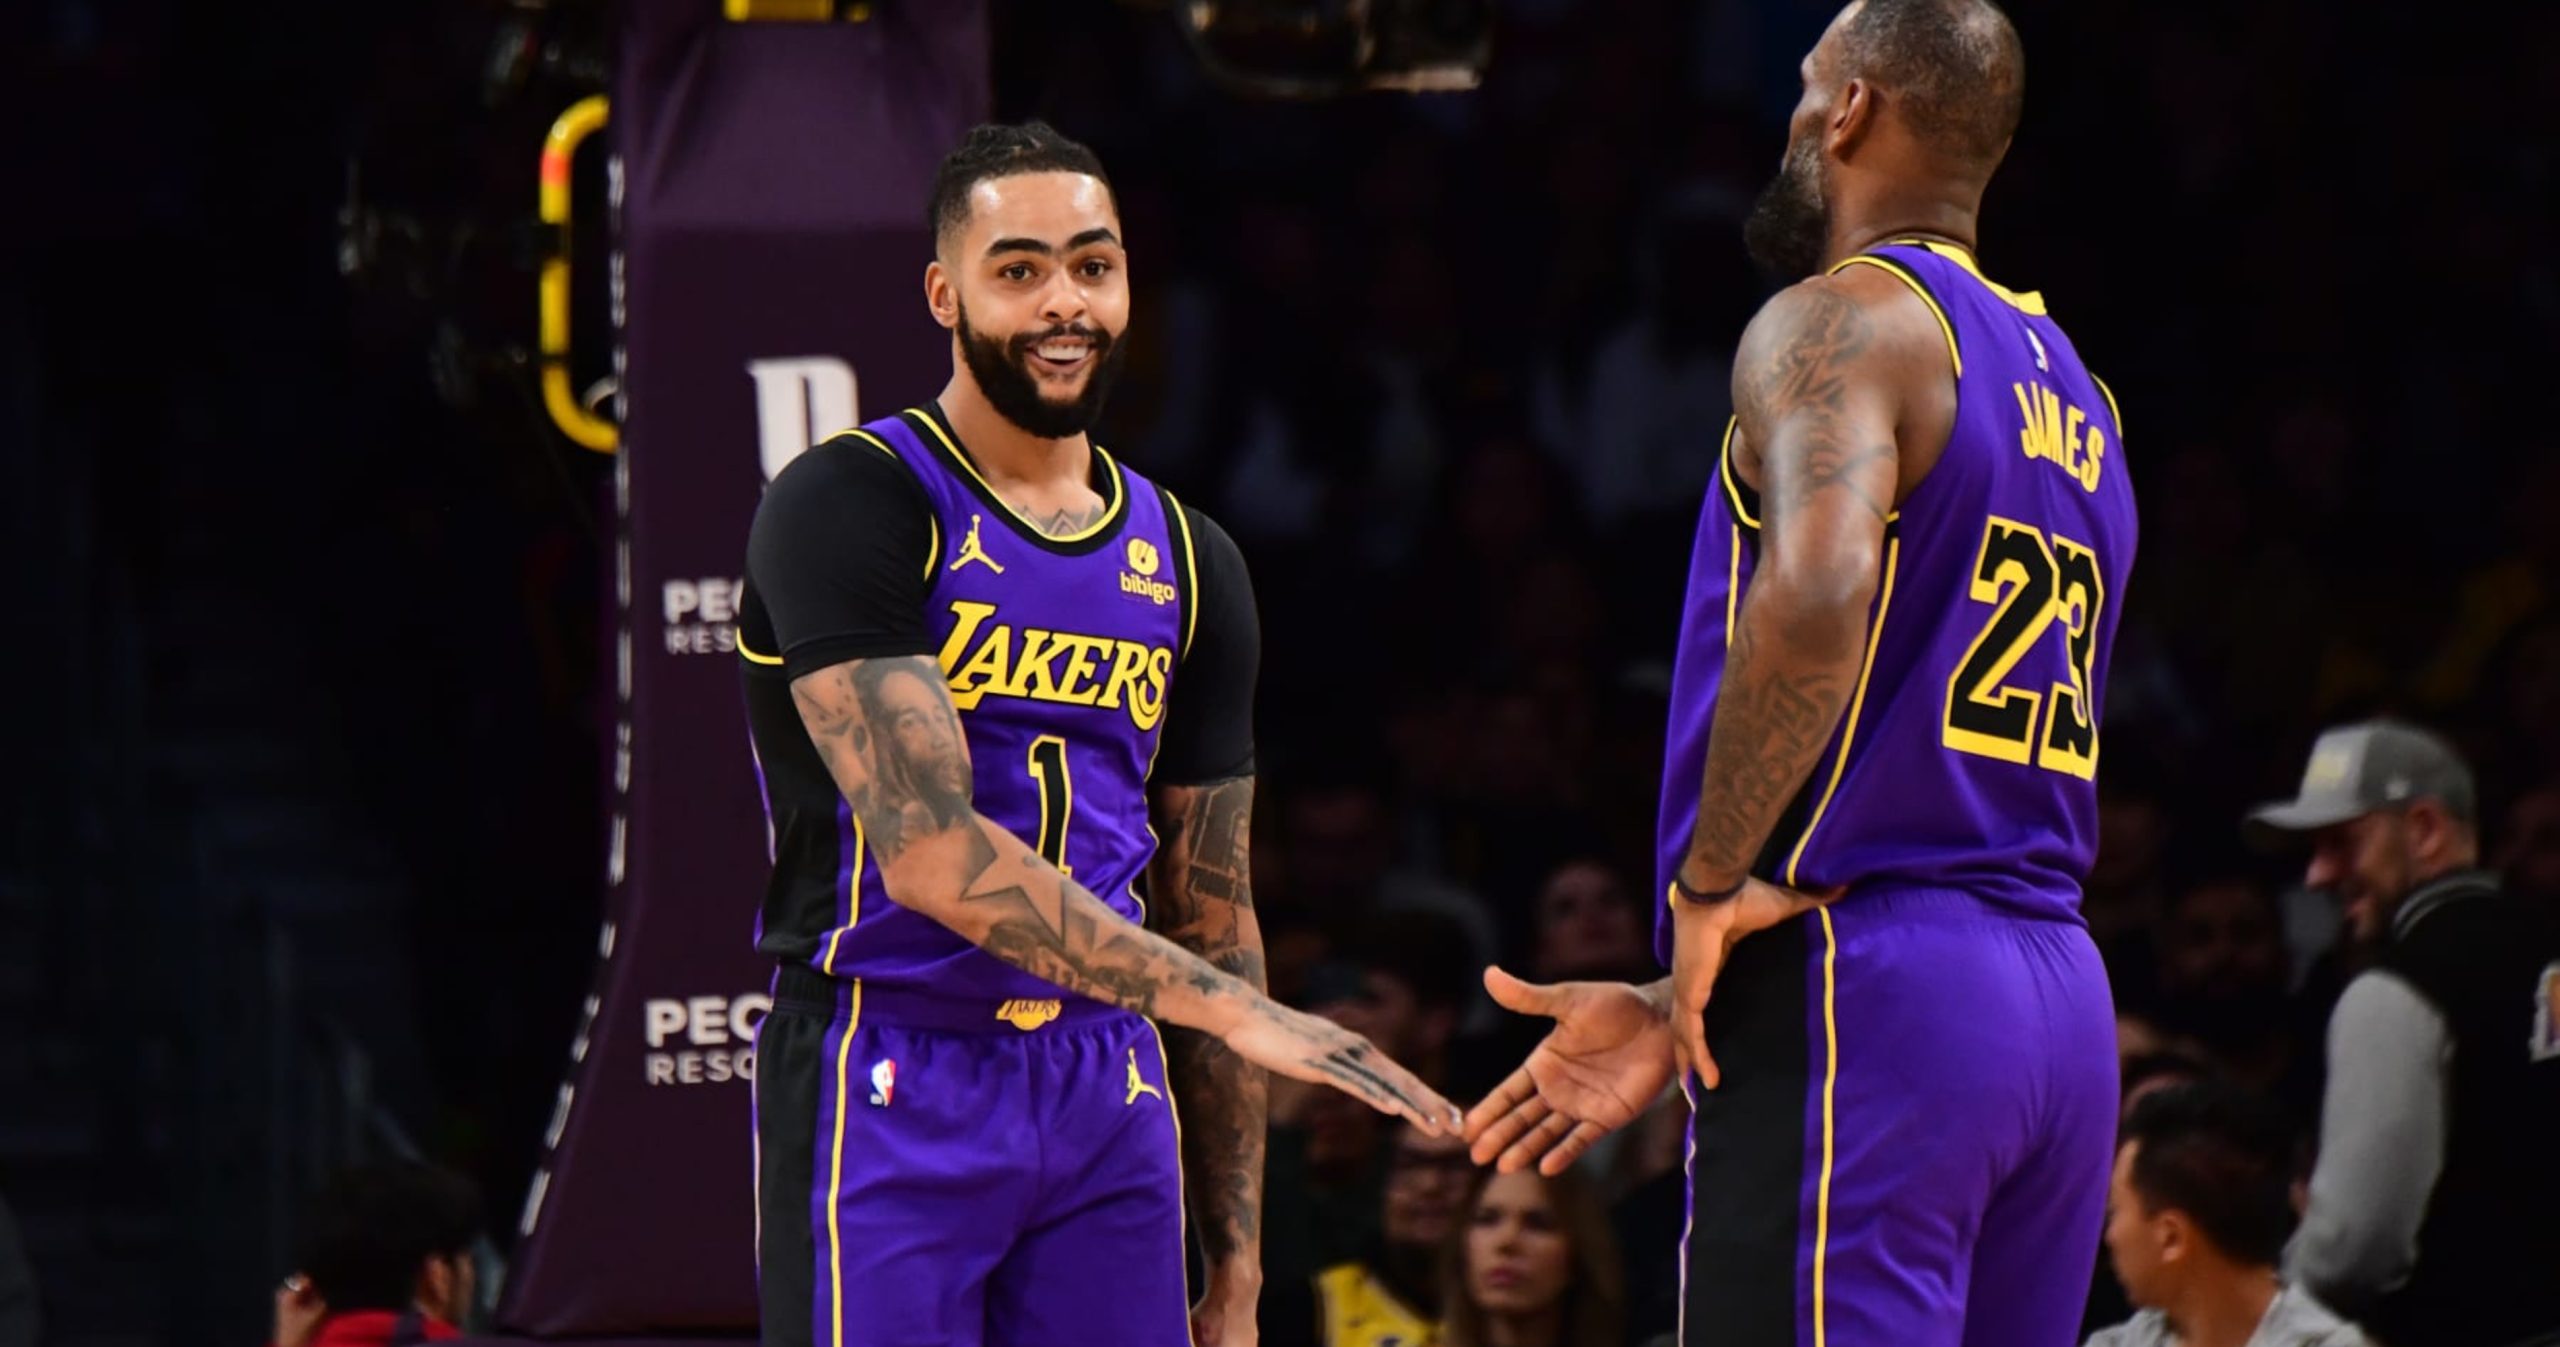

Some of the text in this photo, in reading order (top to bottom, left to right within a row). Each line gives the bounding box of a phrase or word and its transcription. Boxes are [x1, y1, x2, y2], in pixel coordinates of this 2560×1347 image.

[1120, 571, 1175, 606] bibigo
[1942, 514, 2104, 782] 23
[938, 600, 1172, 731] LAKERS
[1028, 734, 1073, 878] 1
[645, 993, 773, 1047] PEC
